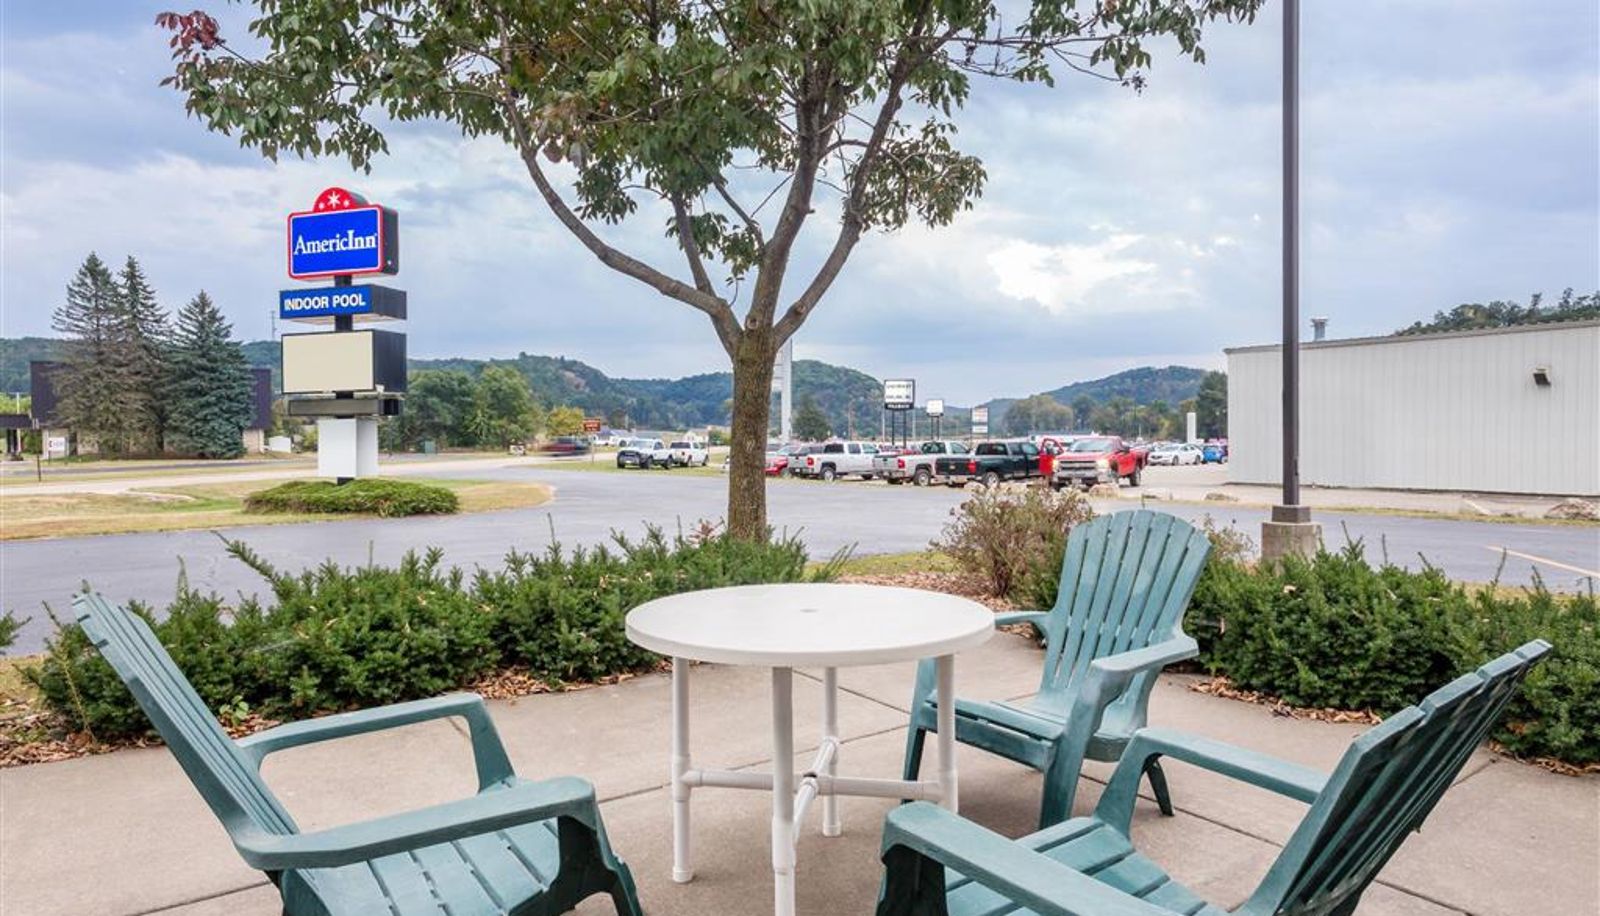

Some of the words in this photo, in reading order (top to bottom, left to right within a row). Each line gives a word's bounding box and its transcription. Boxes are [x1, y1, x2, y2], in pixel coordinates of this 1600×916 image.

[293, 229, 376, 255] AmericInn
[284, 296, 329, 311] INDOOR
[332, 293, 366, 308] POOL
